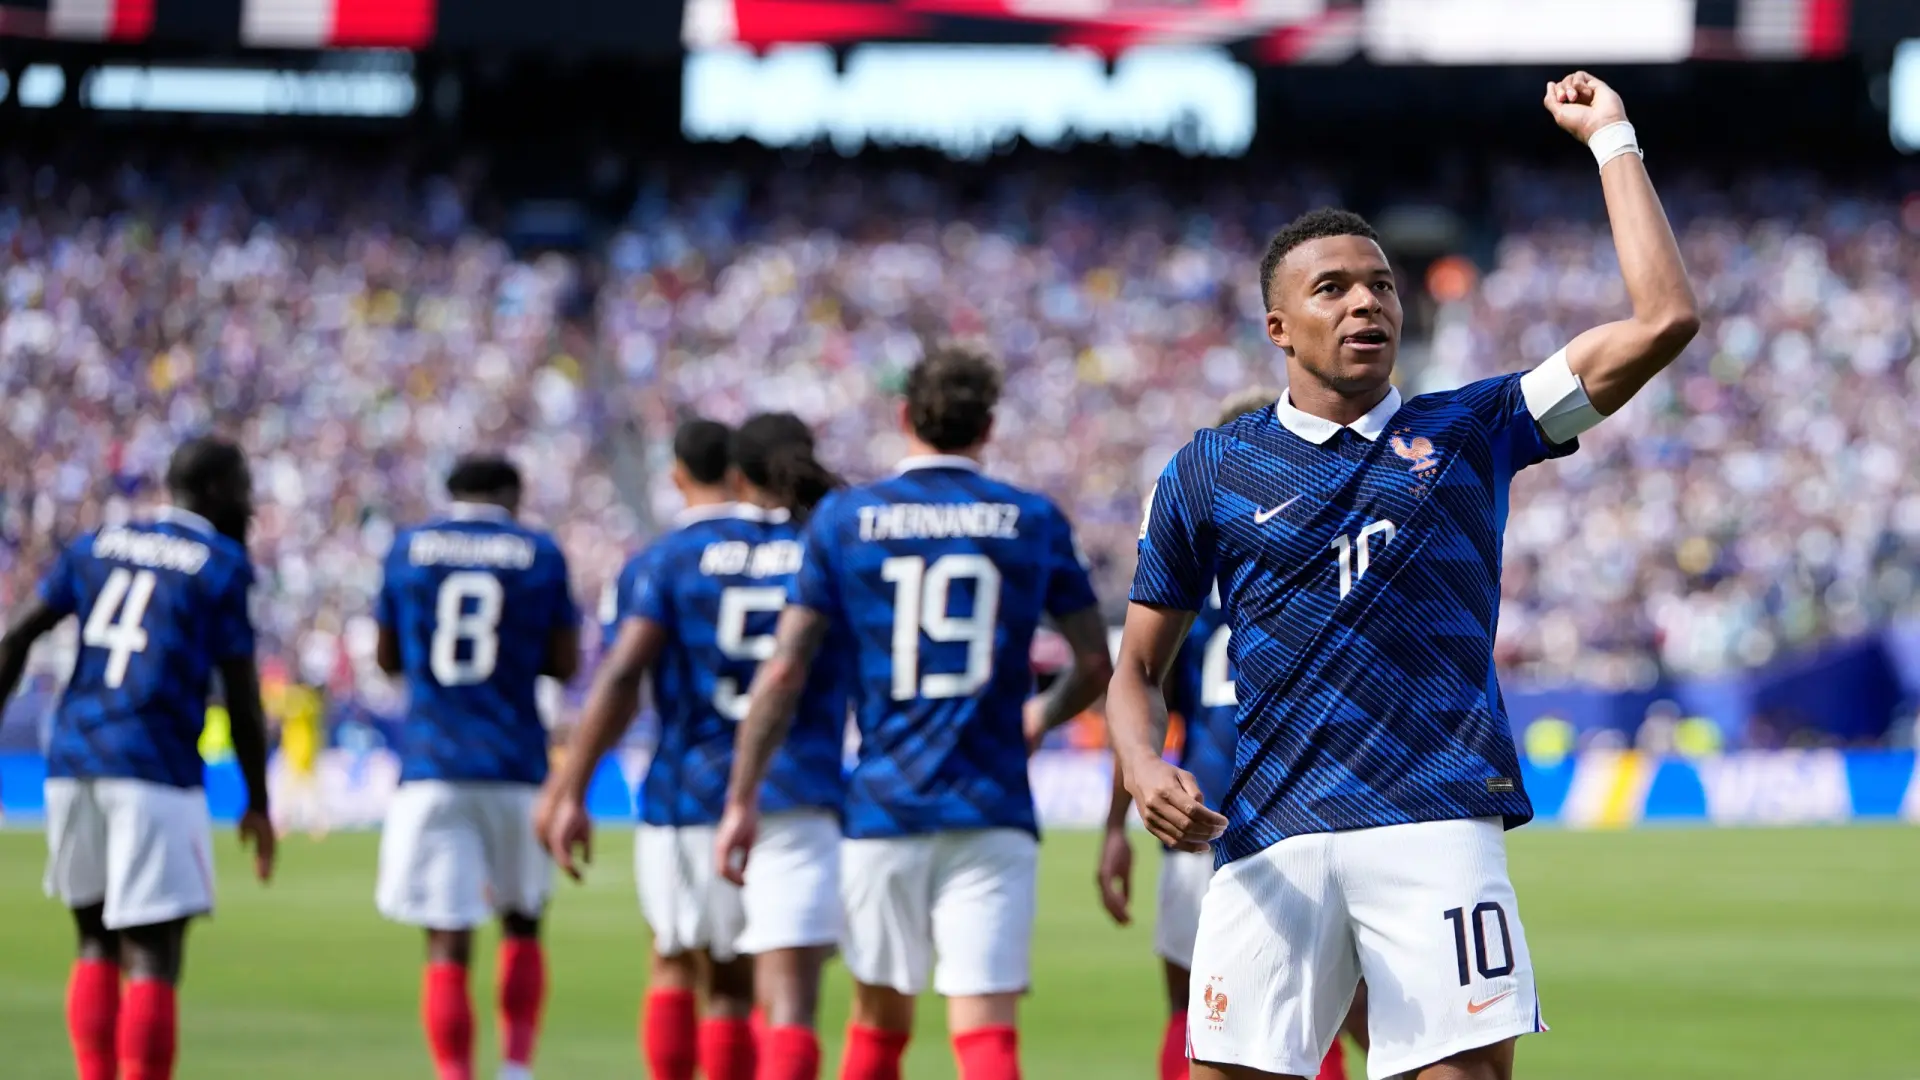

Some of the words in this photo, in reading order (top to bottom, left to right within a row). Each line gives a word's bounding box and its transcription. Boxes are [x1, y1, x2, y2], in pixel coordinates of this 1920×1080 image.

[83, 567, 156, 688] 4
[429, 571, 504, 687] 8
[714, 585, 787, 721] 5
[881, 554, 1001, 701] 19
[1444, 901, 1515, 987] 10
